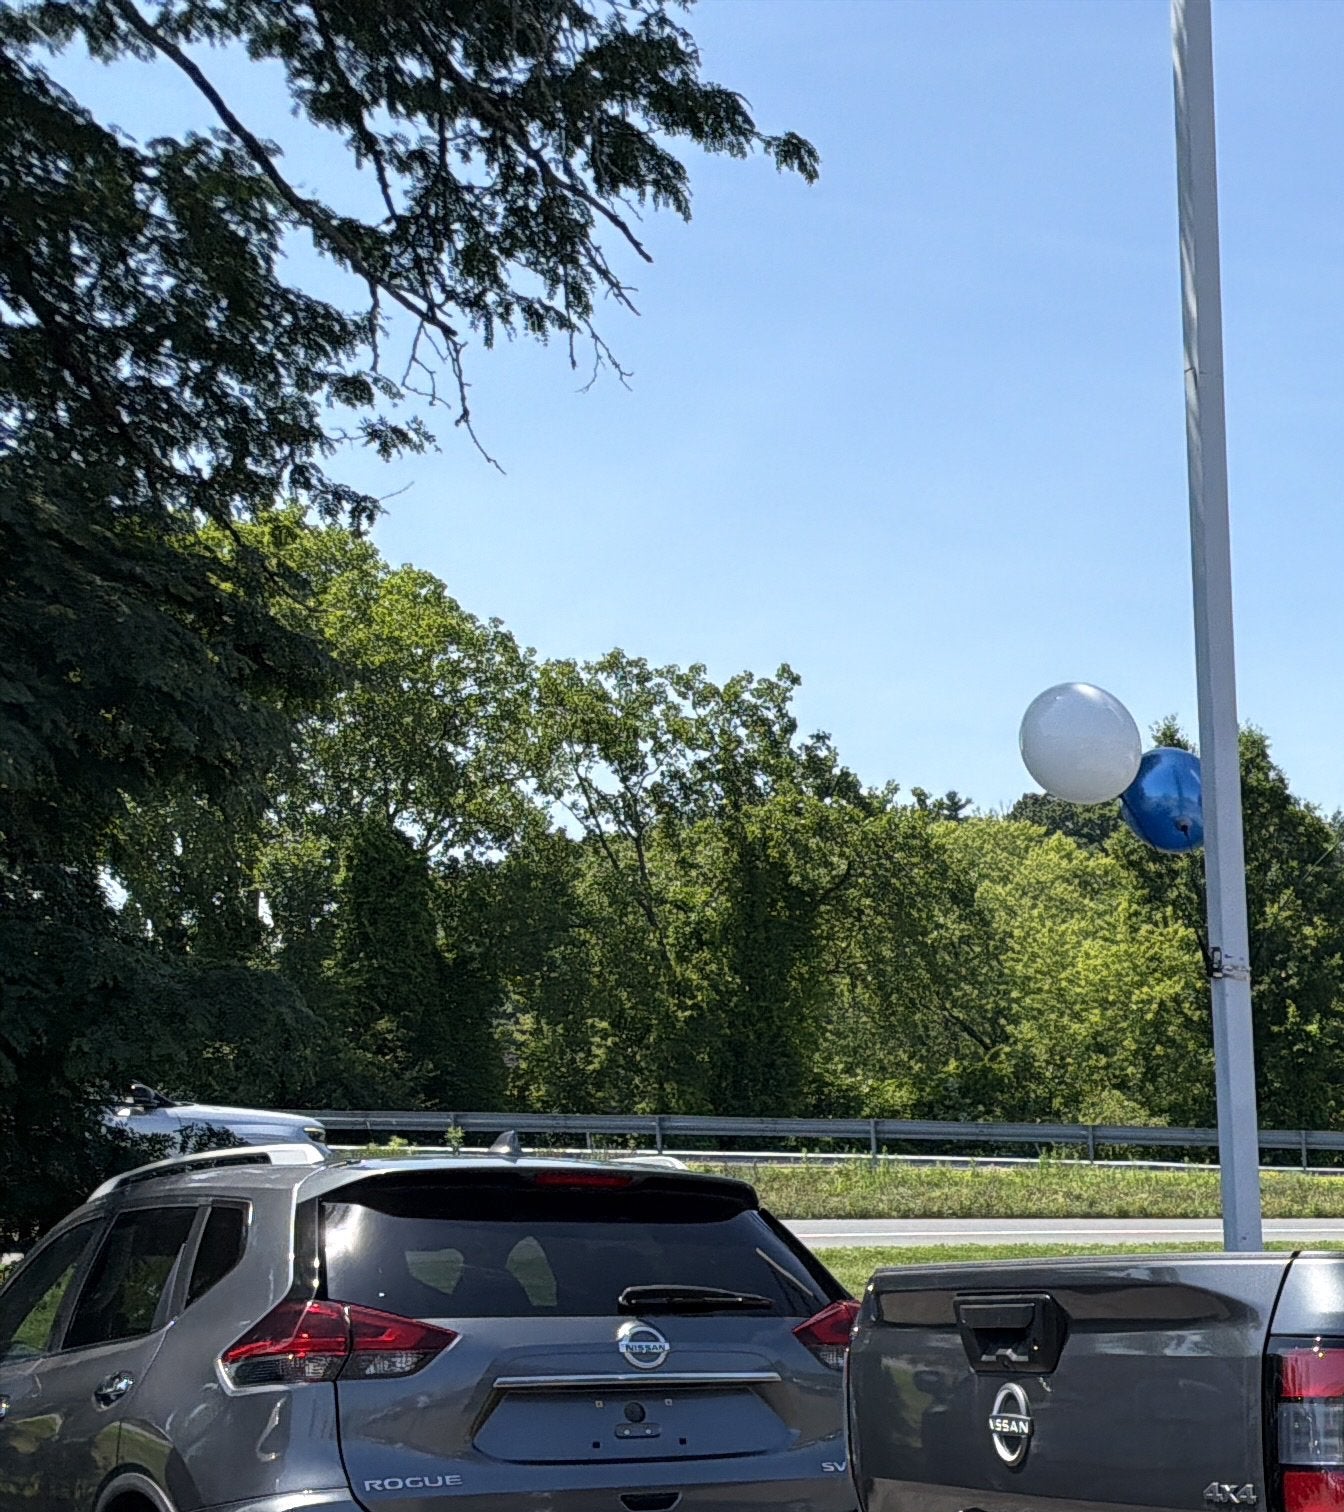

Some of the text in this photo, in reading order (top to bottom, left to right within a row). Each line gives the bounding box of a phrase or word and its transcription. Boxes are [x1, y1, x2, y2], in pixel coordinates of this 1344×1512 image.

[988, 1418, 1029, 1434] ISSAN
[821, 1461, 847, 1472] SV
[363, 1474, 463, 1492] ROGUE
